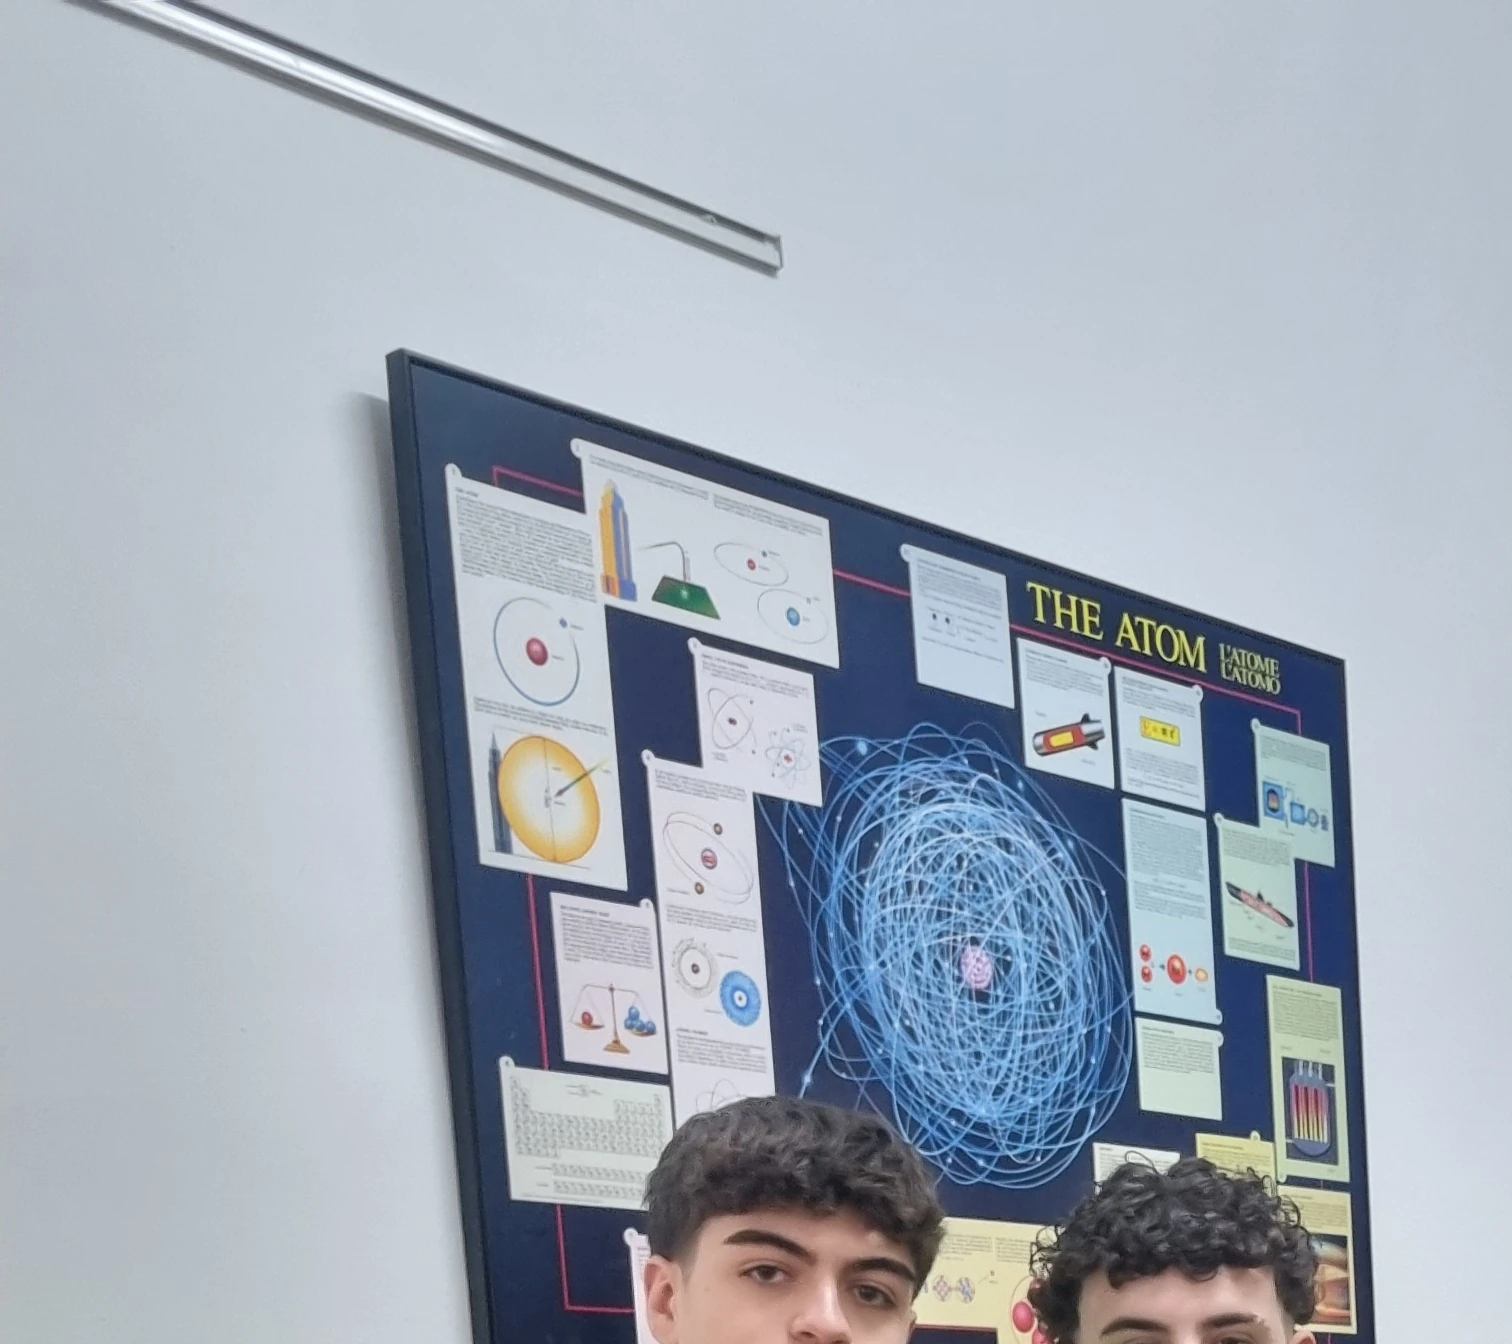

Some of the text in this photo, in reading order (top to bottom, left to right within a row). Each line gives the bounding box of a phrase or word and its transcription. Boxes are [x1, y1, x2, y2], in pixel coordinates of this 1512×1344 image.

[1026, 581, 1103, 640] THE
[1115, 612, 1207, 673] ATOM
[1218, 643, 1280, 678] L'ATOME
[1221, 659, 1281, 695] L'ATOMO
